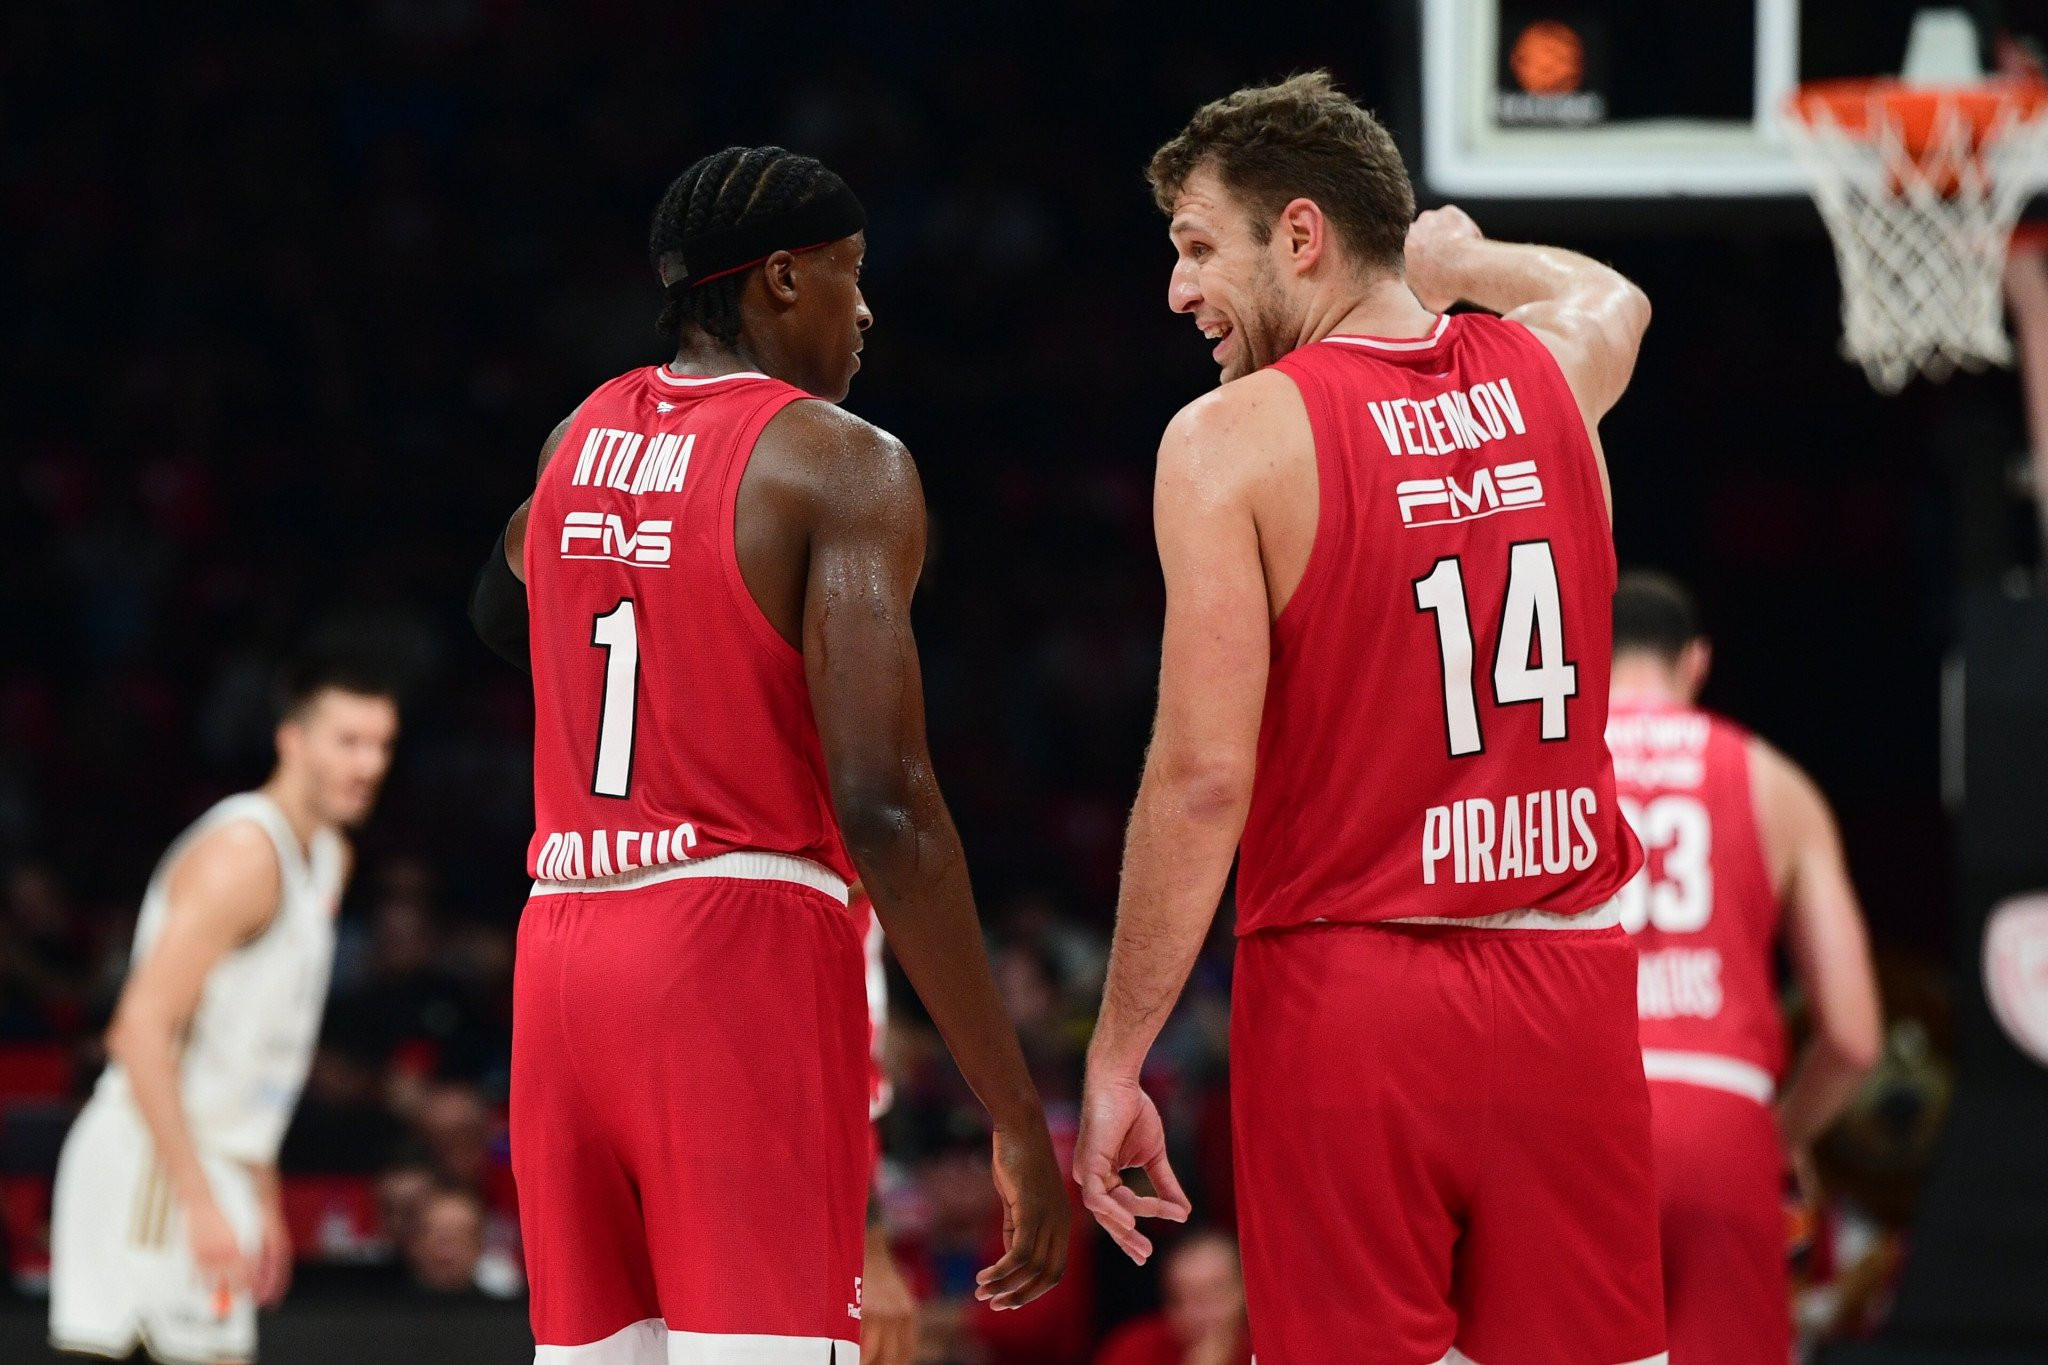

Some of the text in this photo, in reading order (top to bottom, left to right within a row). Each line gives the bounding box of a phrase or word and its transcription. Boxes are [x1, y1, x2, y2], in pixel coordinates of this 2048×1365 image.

[1367, 377, 1526, 456] VEZENKOV
[1397, 460, 1545, 528] FMS
[561, 512, 672, 567] FMS
[1412, 539, 1578, 763] 14
[590, 598, 638, 799] 1
[1422, 787, 1598, 884] PIRAEUS
